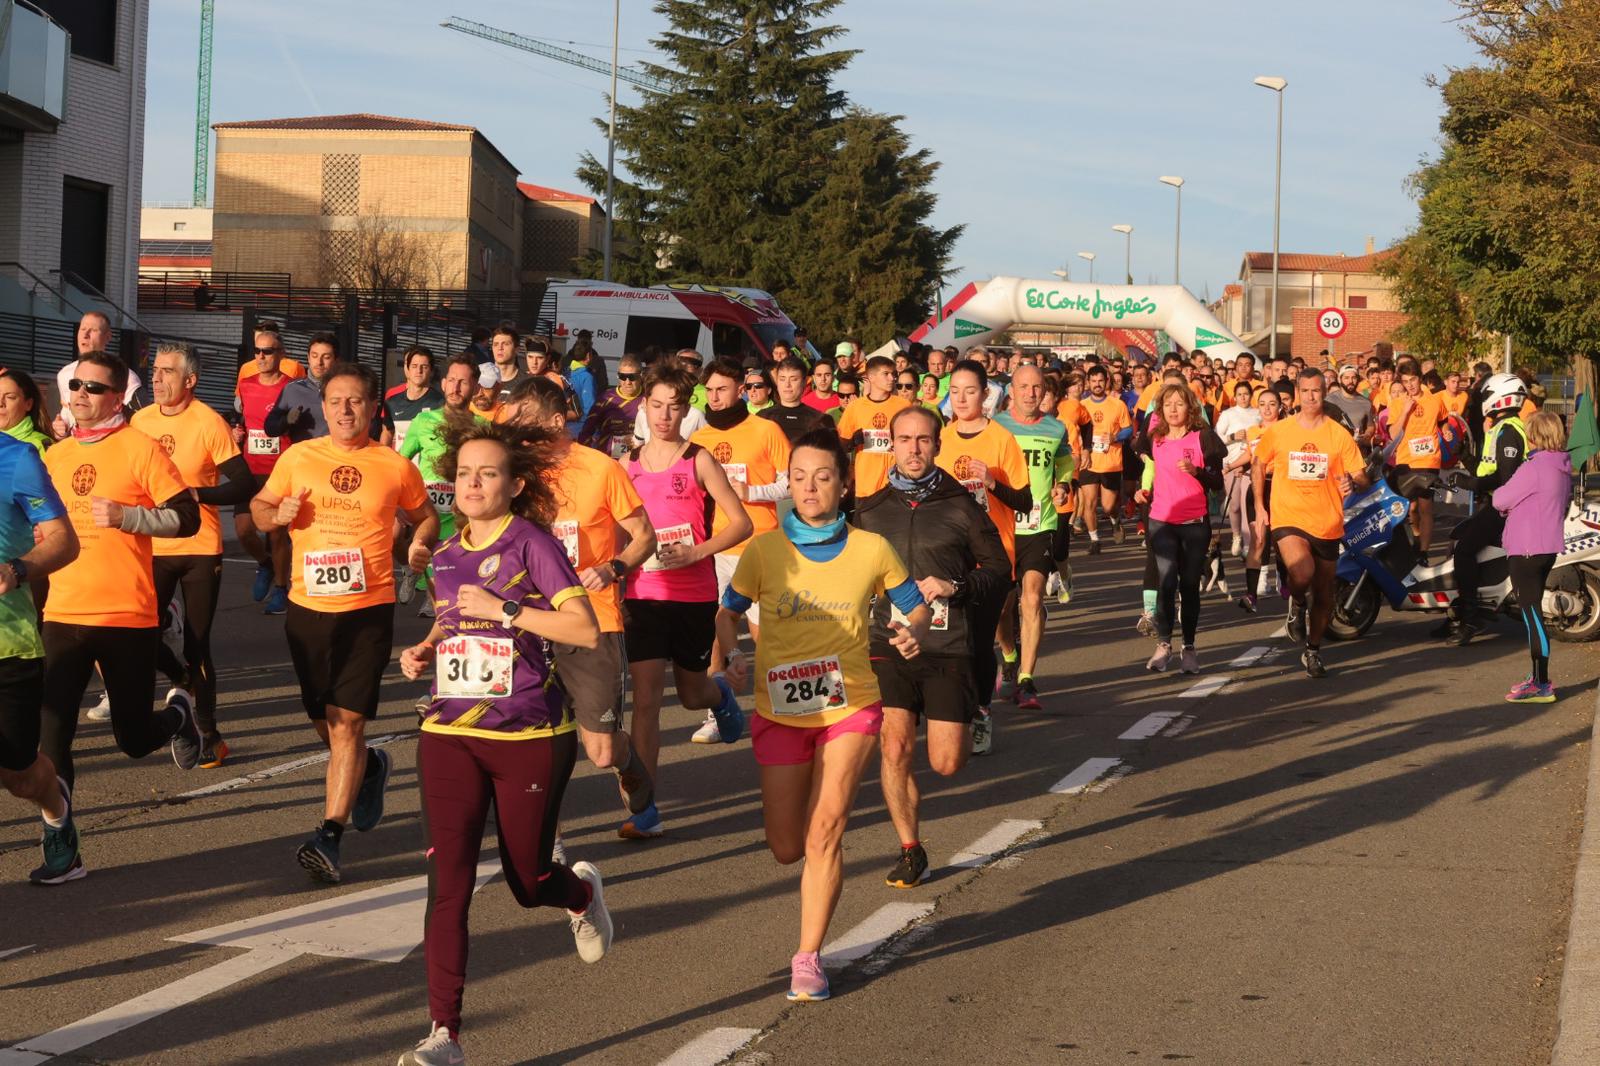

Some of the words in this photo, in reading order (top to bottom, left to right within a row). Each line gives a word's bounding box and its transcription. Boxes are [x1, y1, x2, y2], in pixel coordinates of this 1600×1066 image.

[613, 290, 670, 301] AMBULANCIA
[1026, 288, 1045, 308] El
[1046, 290, 1090, 312] Corte
[1092, 288, 1157, 320] Inglés
[1323, 317, 1341, 329] 30
[572, 328, 594, 337] Cz
[597, 329, 618, 340] Roja
[254, 439, 273, 449] 135
[1300, 462, 1316, 473] 32
[322, 496, 362, 512] UPSA
[430, 491, 455, 506] 367
[1364, 509, 1388, 529] 112
[304, 551, 361, 566] bedunia
[315, 565, 351, 585] 280
[776, 589, 855, 619] Solana
[768, 660, 839, 683] bedunia
[783, 676, 830, 704] 284
